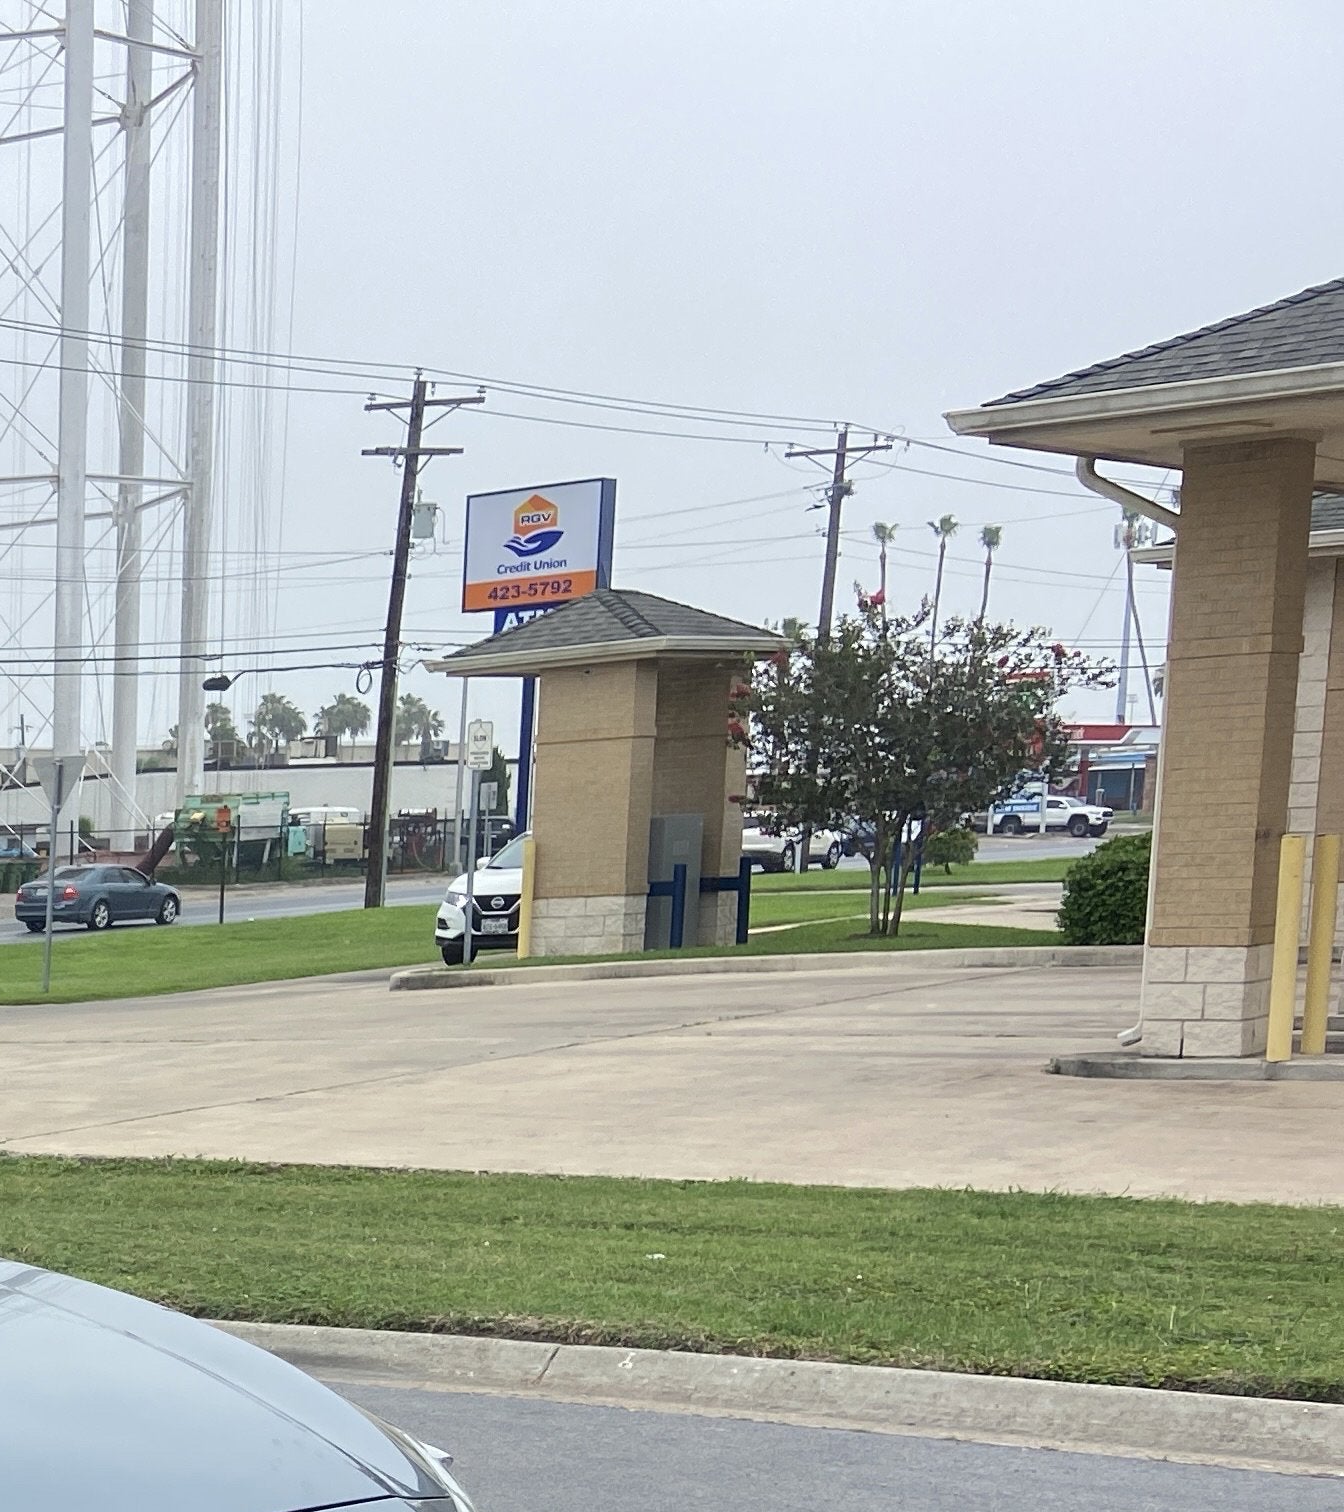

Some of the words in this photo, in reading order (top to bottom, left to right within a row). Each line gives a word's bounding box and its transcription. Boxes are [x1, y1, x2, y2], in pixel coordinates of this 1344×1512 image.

[521, 513, 552, 525] RGV
[497, 561, 532, 575] Credit
[534, 558, 567, 571] Union
[488, 579, 572, 600] 423-5792
